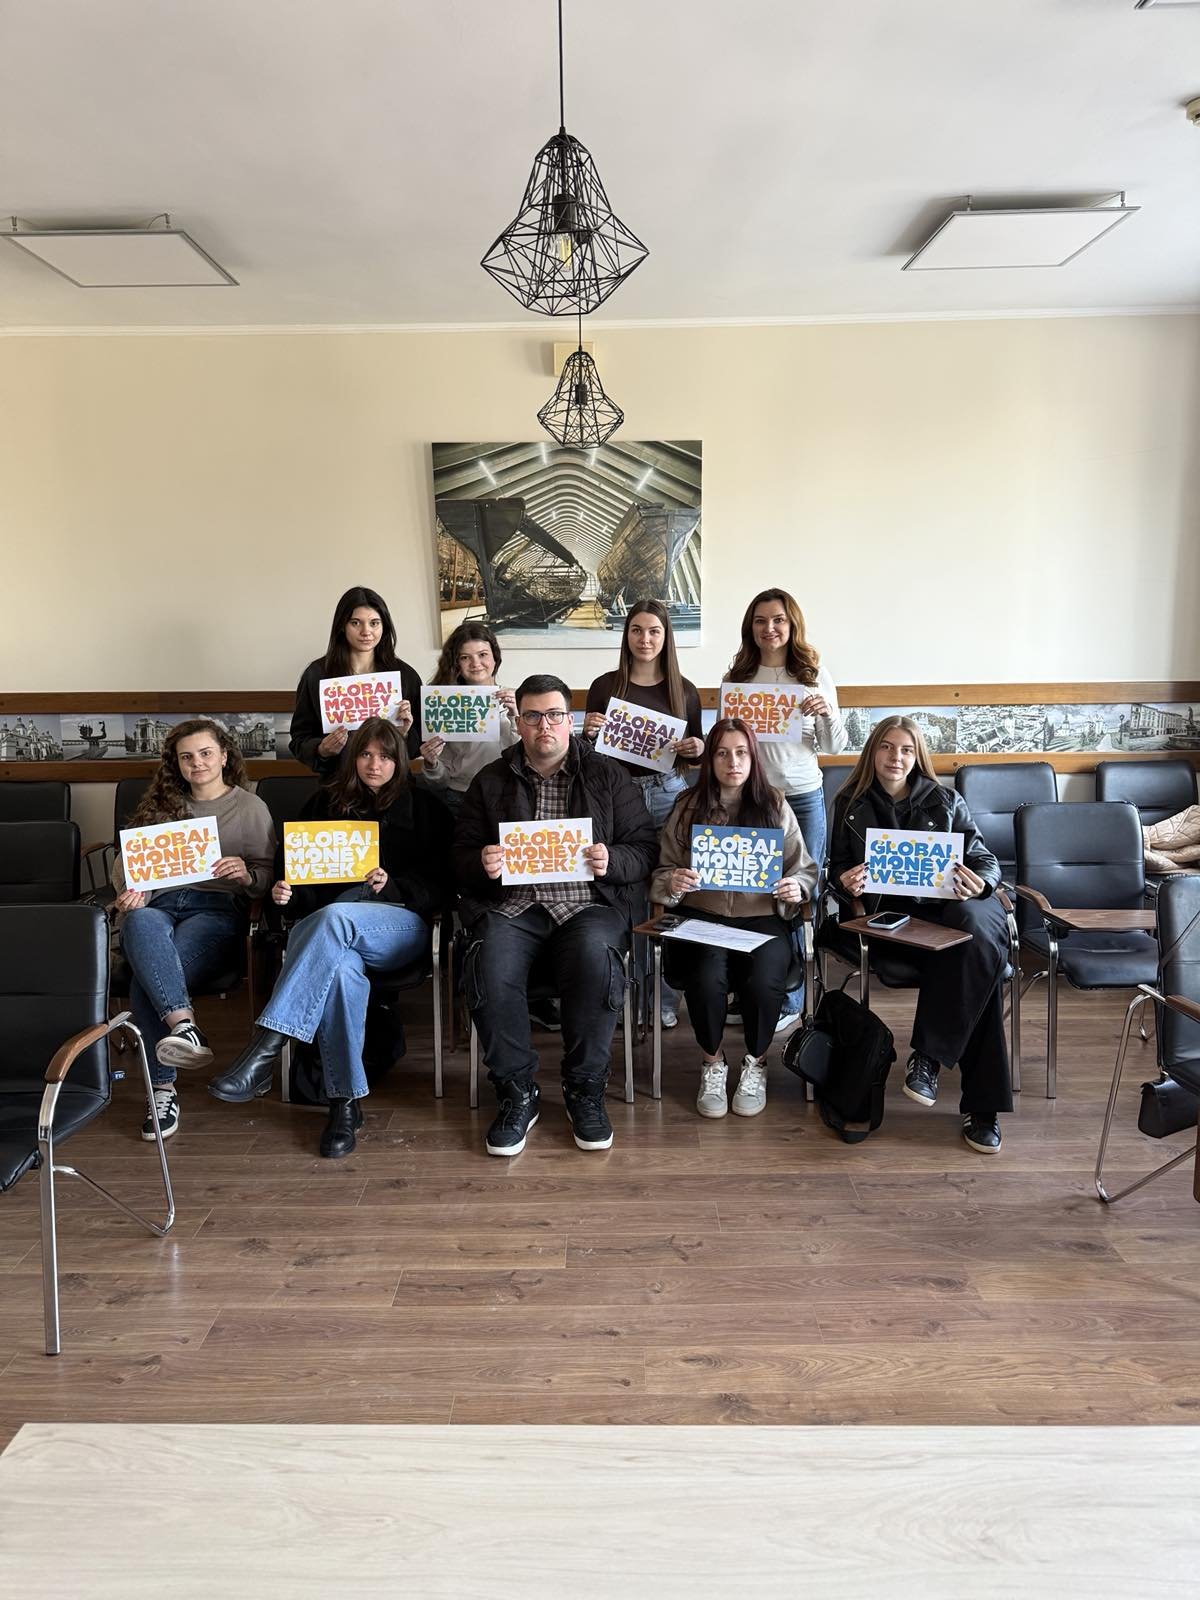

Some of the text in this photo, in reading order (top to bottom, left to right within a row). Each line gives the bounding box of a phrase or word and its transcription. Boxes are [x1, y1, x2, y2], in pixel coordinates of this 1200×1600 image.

[324, 694, 391, 711] MONEY
[424, 696, 496, 708] GLOBAL
[424, 708, 490, 720] MONEY
[724, 706, 794, 720] MONEY
[424, 720, 478, 733] WEEK
[610, 709, 678, 741] GLOBAL
[605, 722, 671, 749] MONEY
[604, 732, 652, 760] WEEK
[126, 828, 216, 853] GLOBAL
[286, 830, 379, 848] GLOBAL
[504, 830, 588, 847] GLOBAL
[692, 835, 783, 856] GLOBAL
[127, 842, 208, 868] MONEY
[286, 846, 370, 864] MONEY
[506, 844, 580, 860] MONEY
[870, 840, 958, 858] GLOBAL
[128, 859, 198, 883] WEEK
[287, 862, 356, 880] WEEK
[506, 858, 568, 875] WEEK
[692, 852, 774, 872] MONEY
[870, 854, 950, 872] MONEY
[692, 867, 759, 888] WEEK
[870, 868, 934, 887] WEEK
